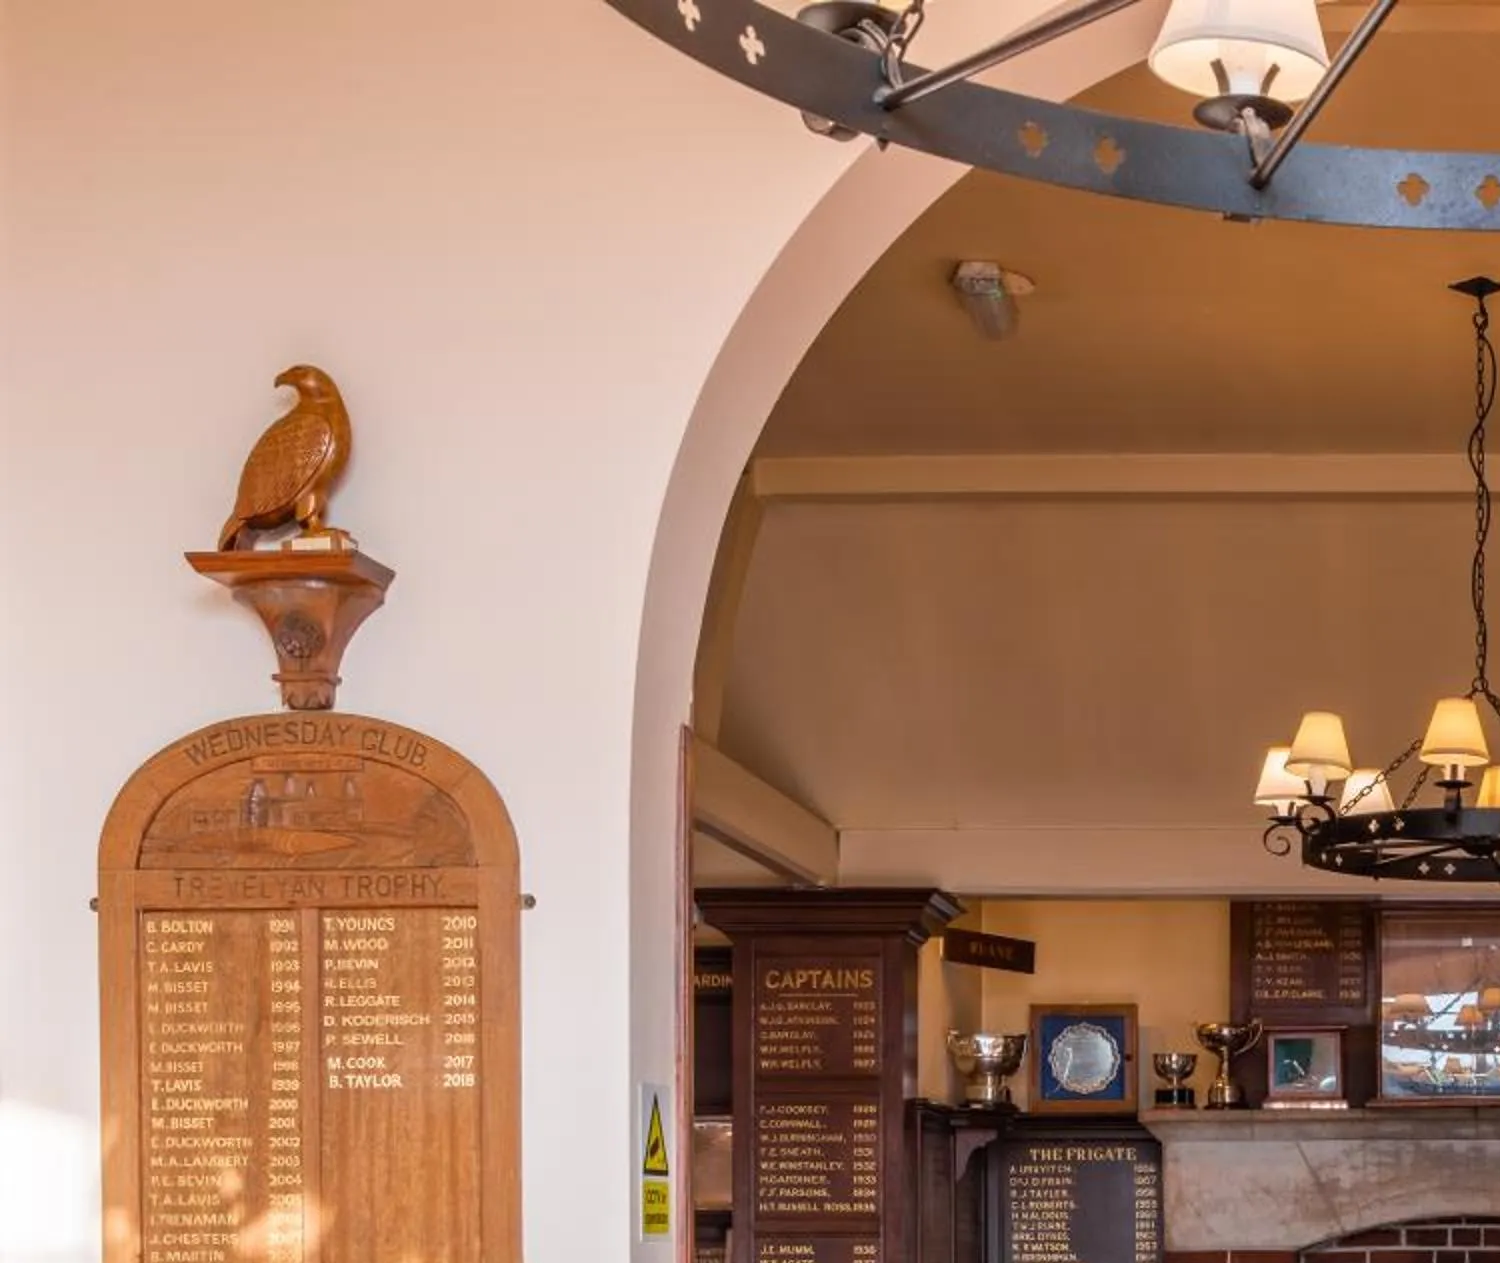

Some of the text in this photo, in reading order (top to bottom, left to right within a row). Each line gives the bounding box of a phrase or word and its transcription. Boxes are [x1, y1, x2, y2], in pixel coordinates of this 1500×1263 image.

[184, 720, 353, 768] WEDNESDAY
[172, 875, 326, 899] TREVELYAN
[443, 917, 477, 930] 2010
[443, 938, 474, 950] 2011
[444, 976, 474, 988] 2013
[765, 970, 874, 989] CAPTAINS
[445, 995, 475, 1006] 2014
[445, 1014, 475, 1025] 2015
[343, 1033, 404, 1045] SEWELL
[347, 1057, 386, 1069] COOK
[443, 1056, 474, 1069] 2017
[346, 1075, 402, 1088] TAYLOR
[443, 1075, 475, 1087] 2018
[269, 1117, 295, 1128] 2001
[1029, 1148, 1137, 1161] THE FRIGATE
